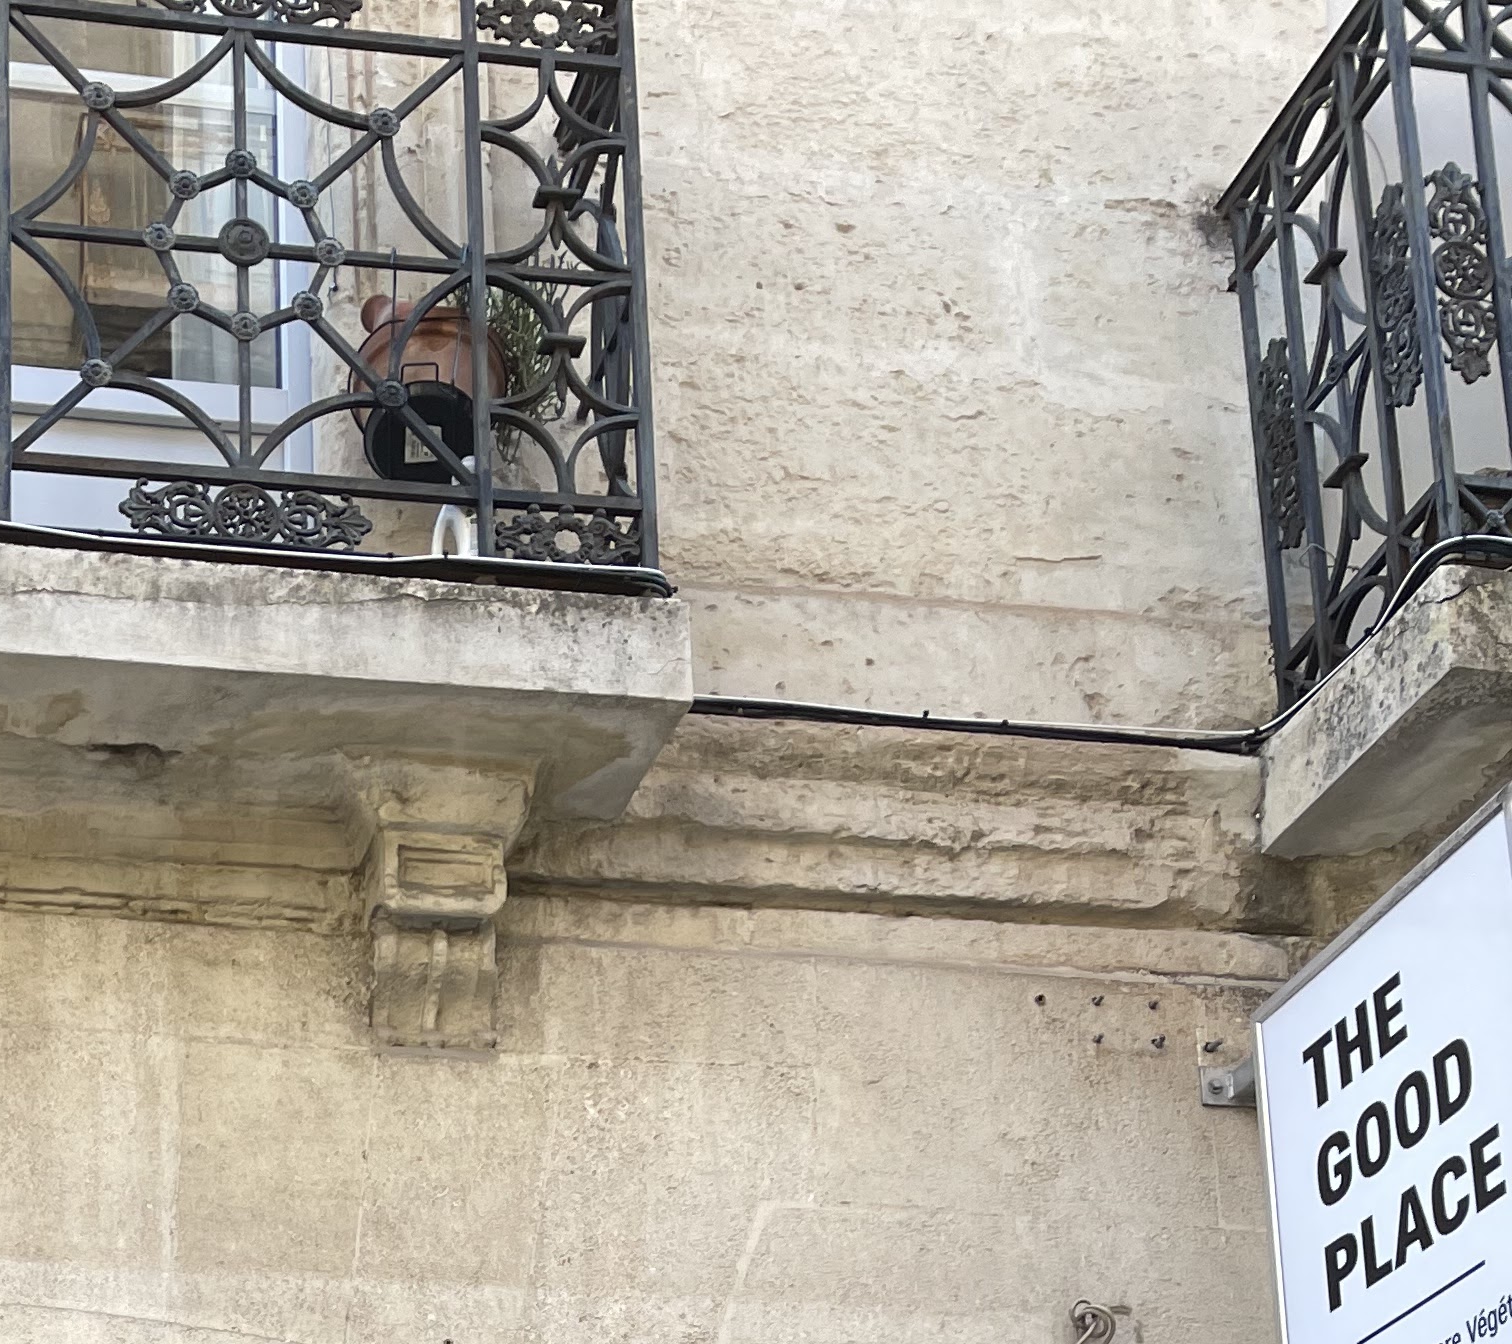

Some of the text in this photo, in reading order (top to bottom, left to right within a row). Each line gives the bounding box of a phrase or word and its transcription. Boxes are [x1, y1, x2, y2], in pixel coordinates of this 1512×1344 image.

[1302, 970, 1408, 1109] THE
[1317, 1038, 1473, 1207] GOOD
[1324, 1123, 1508, 1313] PLACE
